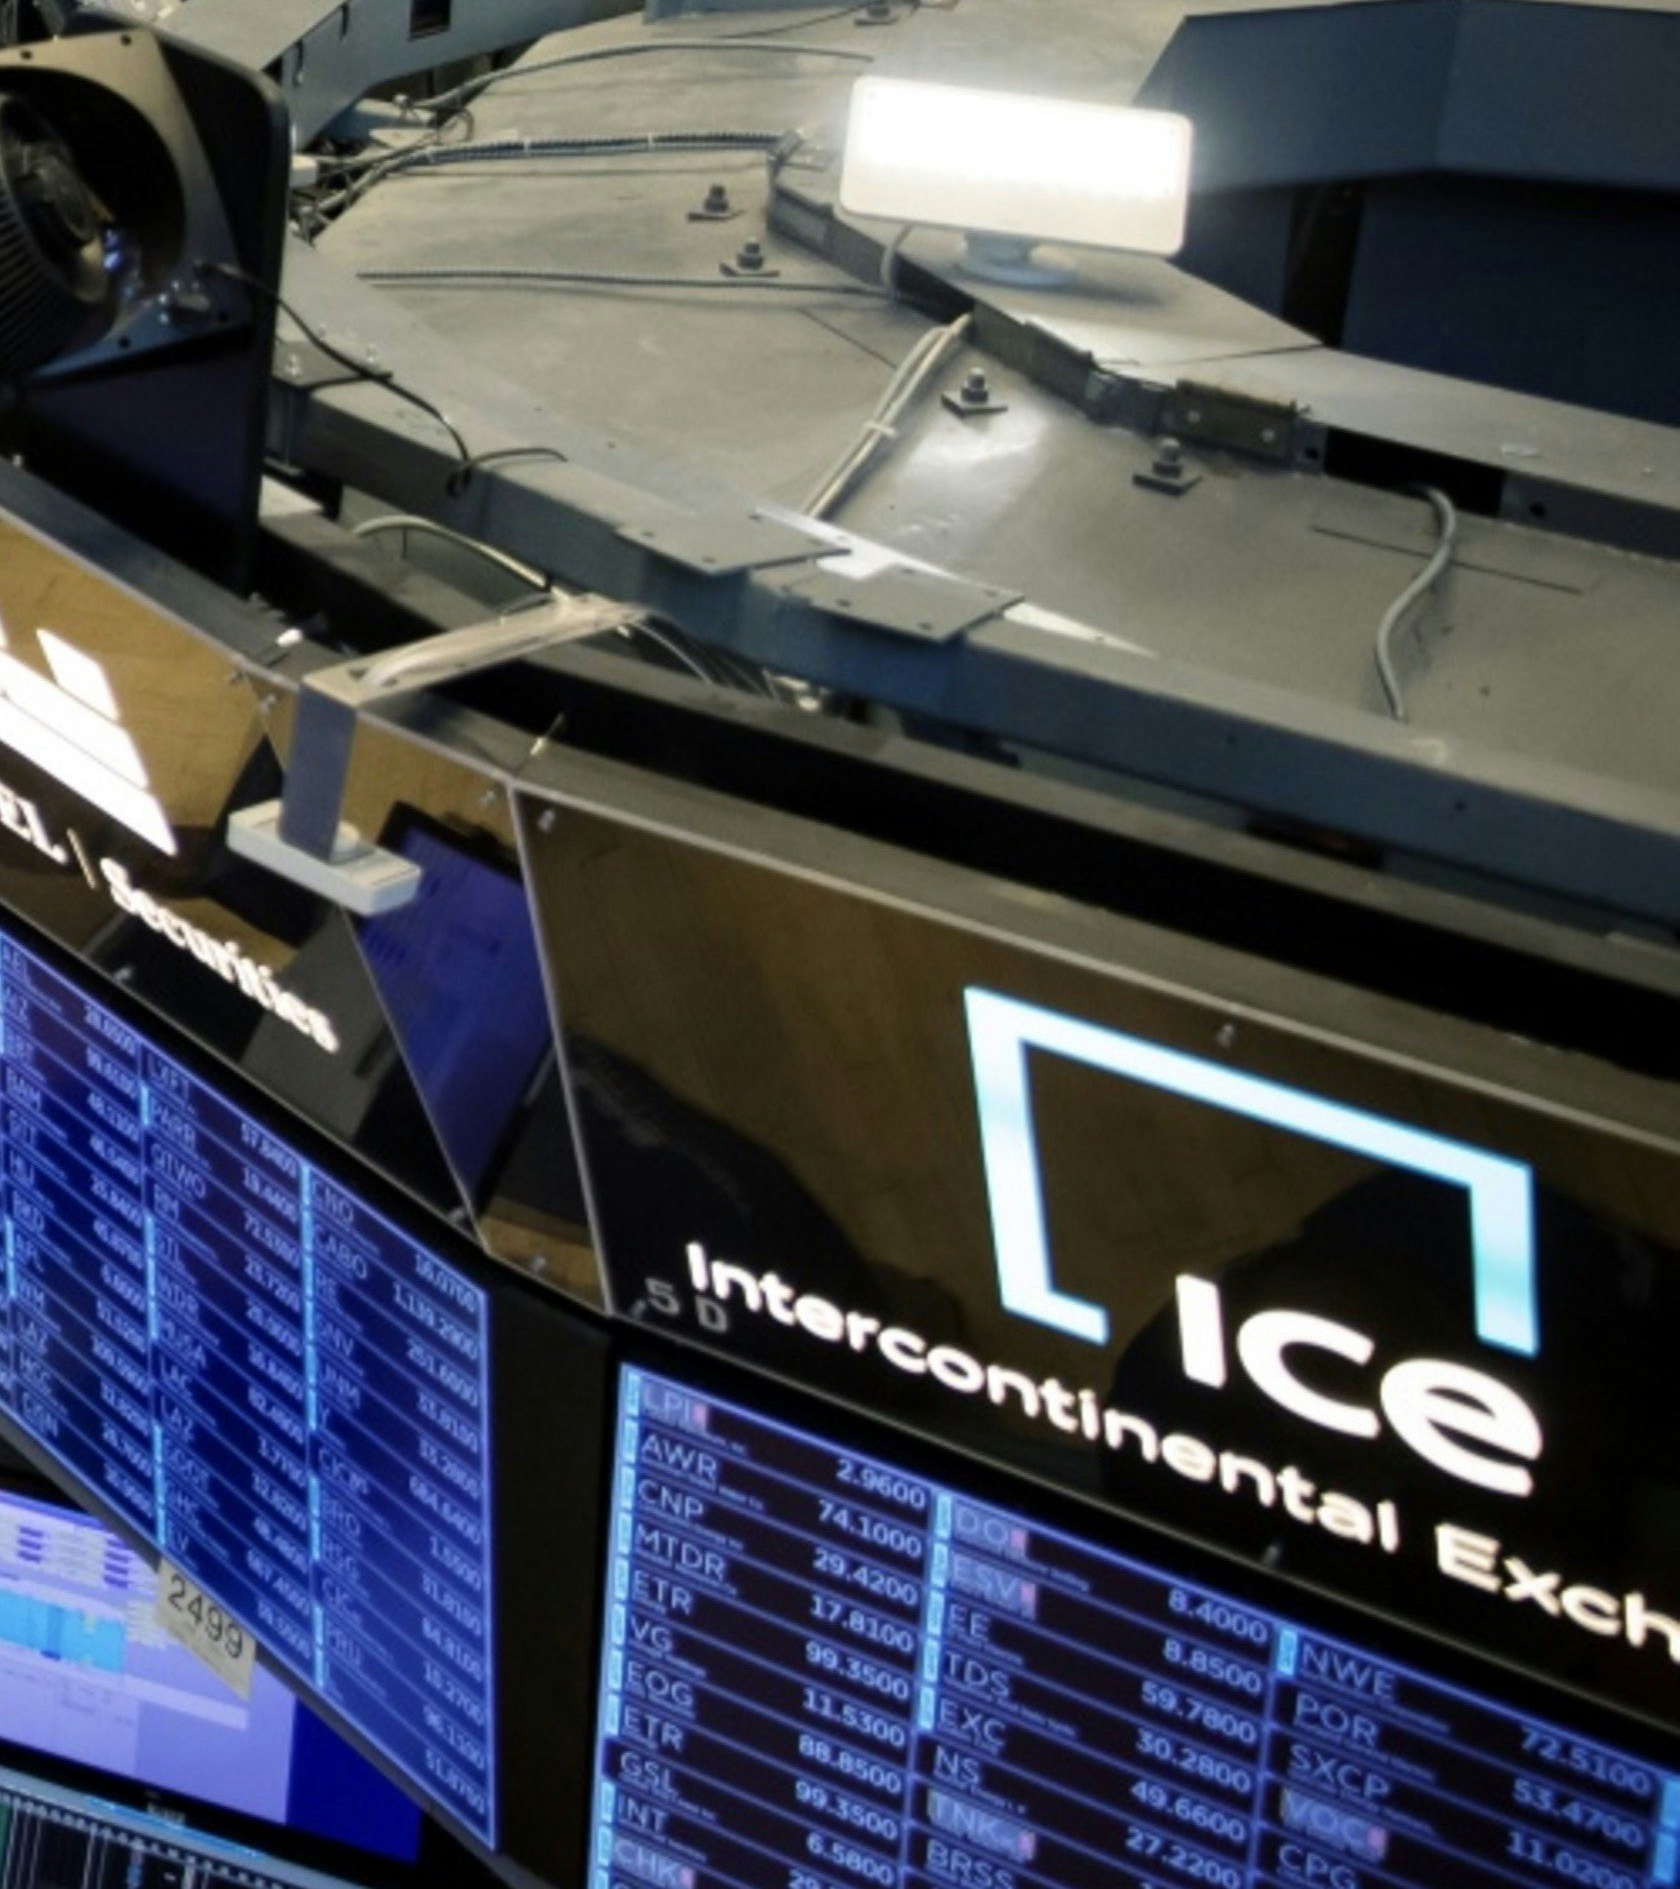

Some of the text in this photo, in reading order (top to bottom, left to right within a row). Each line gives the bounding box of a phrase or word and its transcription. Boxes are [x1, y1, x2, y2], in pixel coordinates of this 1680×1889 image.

[98, 858, 340, 1054] Securities
[1176, 1272, 1543, 1498] ICE
[641, 1431, 922, 1559] AWR 74.1000
[686, 1241, 1680, 1666] Intercontinental Exch
[835, 1457, 927, 1510] 2.9600
[636, 1524, 915, 1653] MTDR 17.8100
[637, 1477, 918, 1607] CNP 29.4200
[164, 1574, 247, 1660] 2499
[628, 1617, 907, 1749] VG 11.5300
[634, 1570, 910, 1701] ETR 99.3500
[949, 1604, 1257, 1746] EE 59.7800
[1162, 1637, 1263, 1695] 8.8500
[1168, 1589, 1269, 1644] 8.4000
[623, 1708, 899, 1841] ETR 99.3500
[626, 1661, 903, 1796] EOG 88.8500
[939, 1698, 1246, 1843] EXC 49.6600
[947, 1651, 1252, 1795] TDS 30.2800
[1294, 1692, 1644, 1849] POR 53.4700
[1302, 1642, 1652, 1796] NWE 72.5100
[618, 1794, 671, 1834] INT
[620, 1751, 897, 1889] GSL 6.5800
[936, 1746, 1241, 1889] NS 27.2200
[1289, 1744, 1636, 1889] SXCP 11.0200
